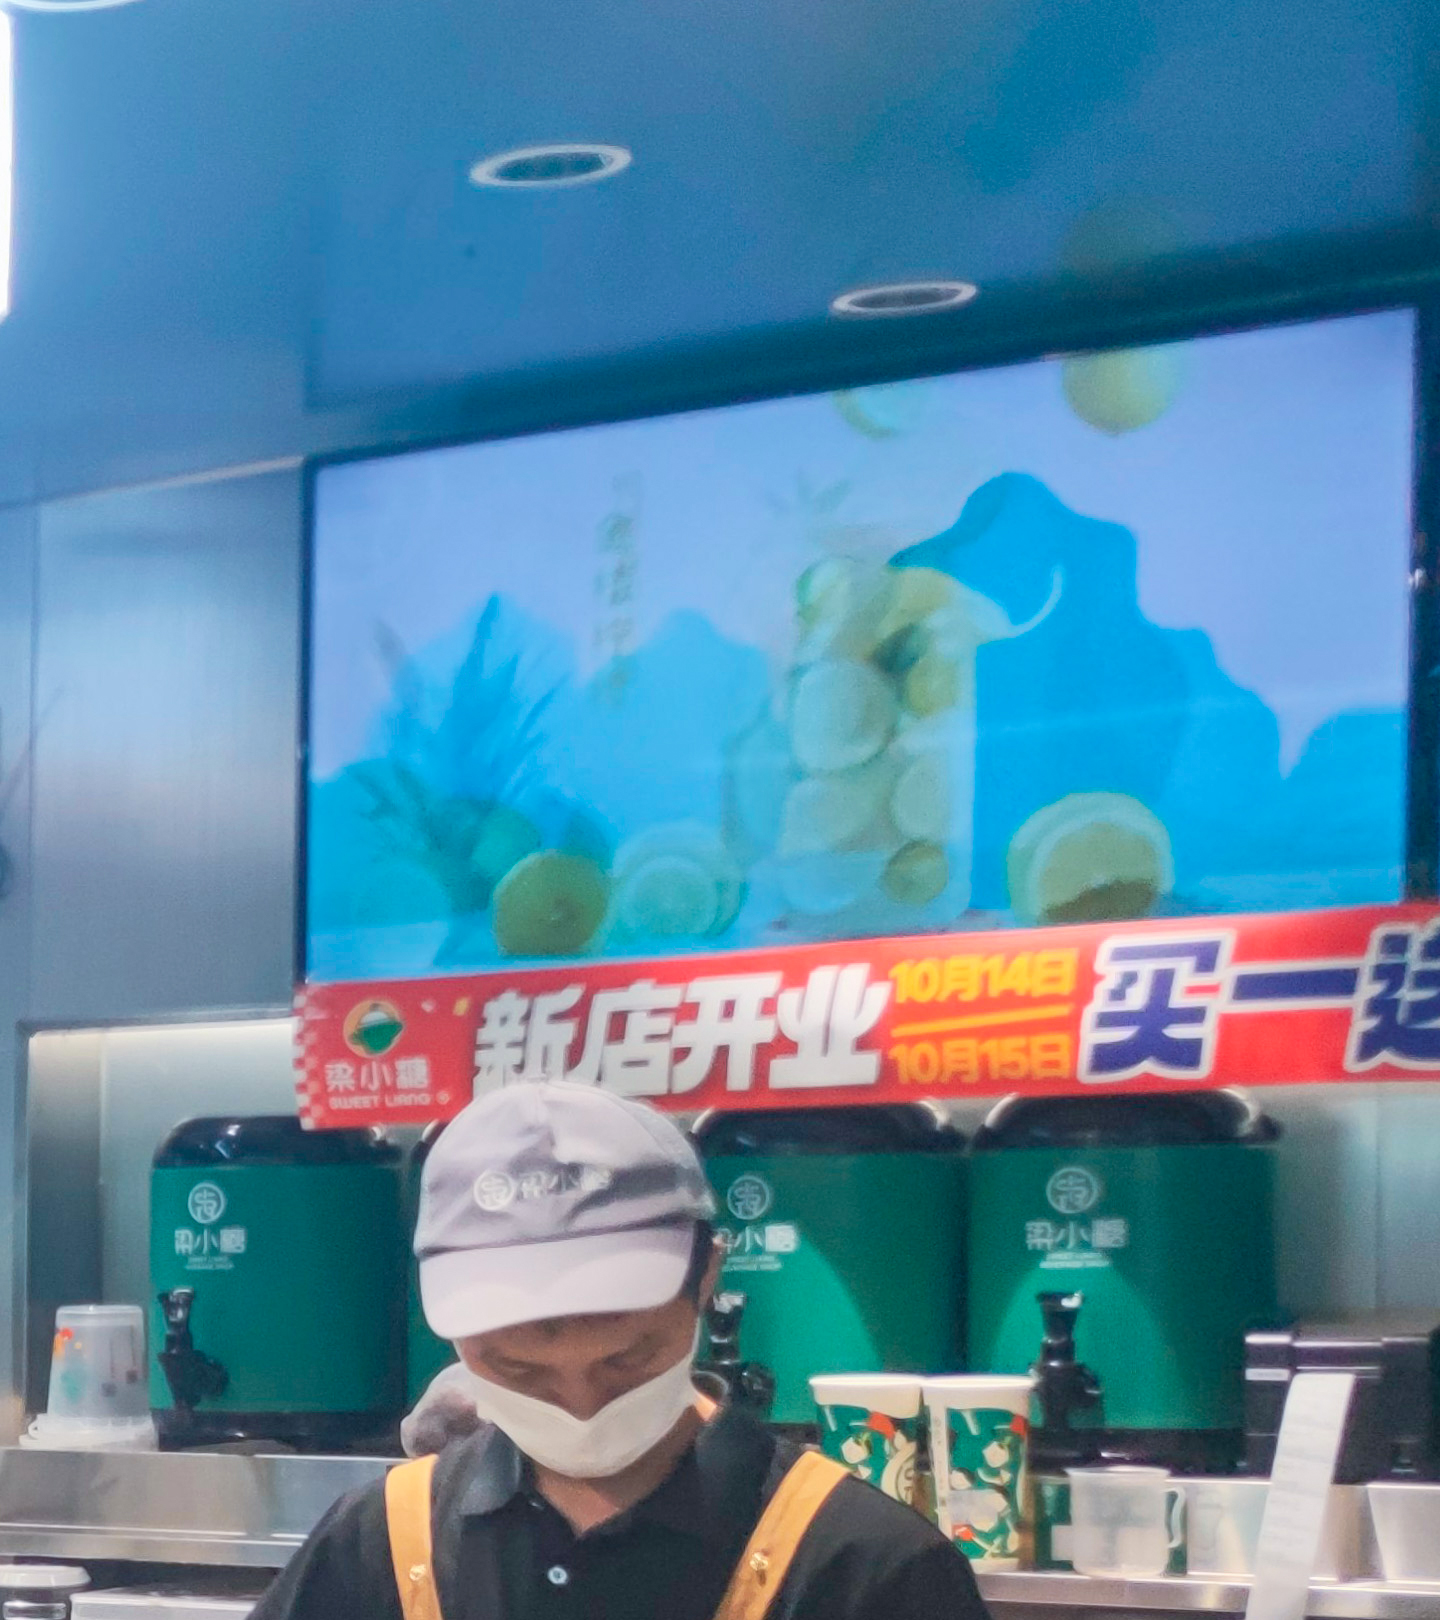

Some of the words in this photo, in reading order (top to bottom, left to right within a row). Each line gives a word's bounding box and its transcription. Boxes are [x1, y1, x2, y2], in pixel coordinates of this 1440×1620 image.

[890, 948, 1080, 1003] 10月14日
[474, 962, 891, 1098] 新店开业
[890, 1034, 1075, 1084] 10月15日
